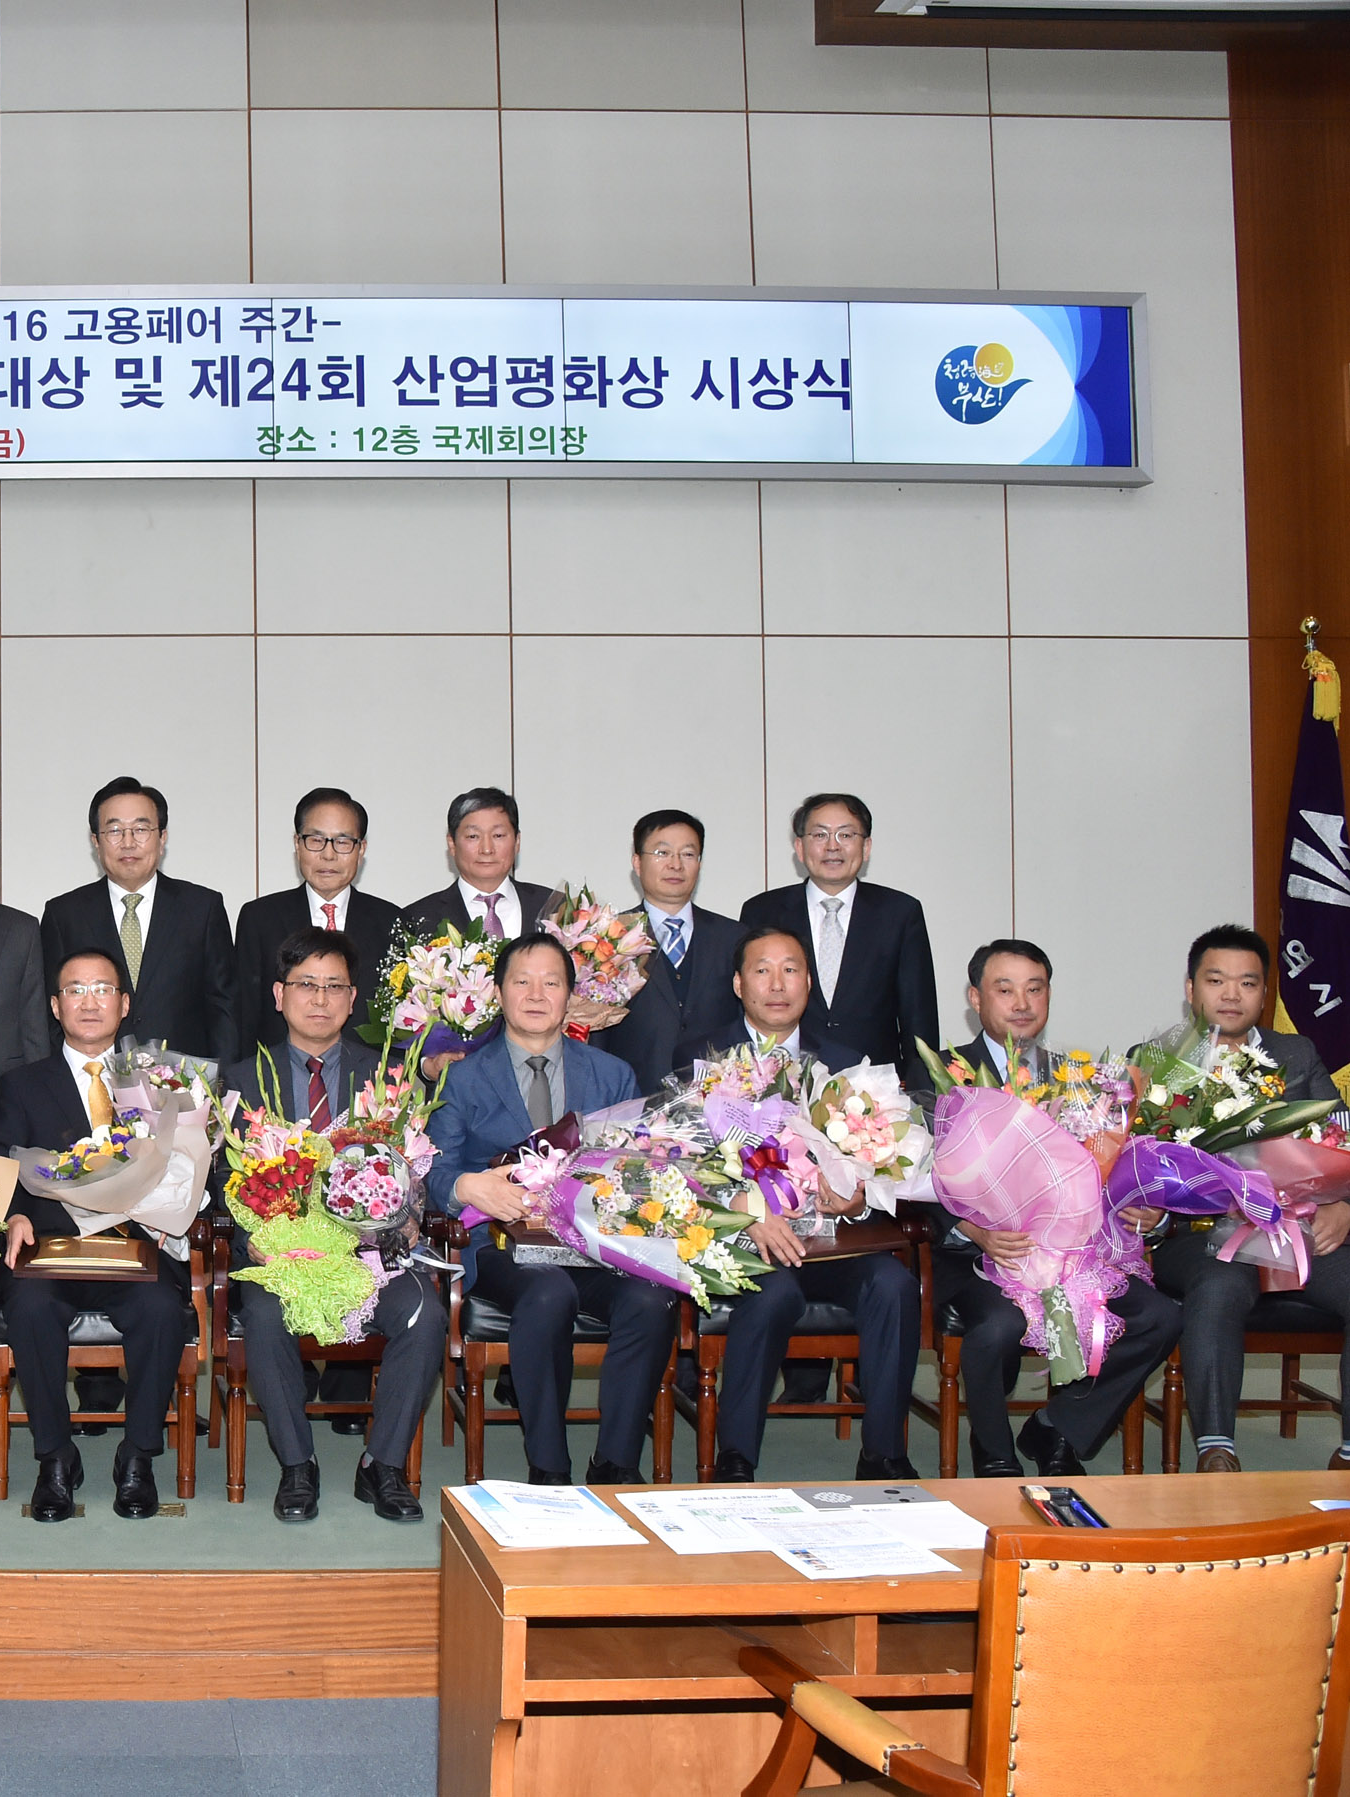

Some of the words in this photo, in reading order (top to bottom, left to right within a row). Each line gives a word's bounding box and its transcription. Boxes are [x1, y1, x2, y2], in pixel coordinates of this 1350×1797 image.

[64, 306, 222, 344] 고용페어
[115, 355, 163, 409] 및
[189, 354, 366, 408] 제24회
[392, 354, 670, 409] 산업평화상
[690, 356, 850, 411] 시상식
[951, 381, 1004, 423] 부산!
[256, 425, 317, 455] 장소
[353, 425, 421, 455] 12층
[433, 425, 588, 455] 국제회의장
